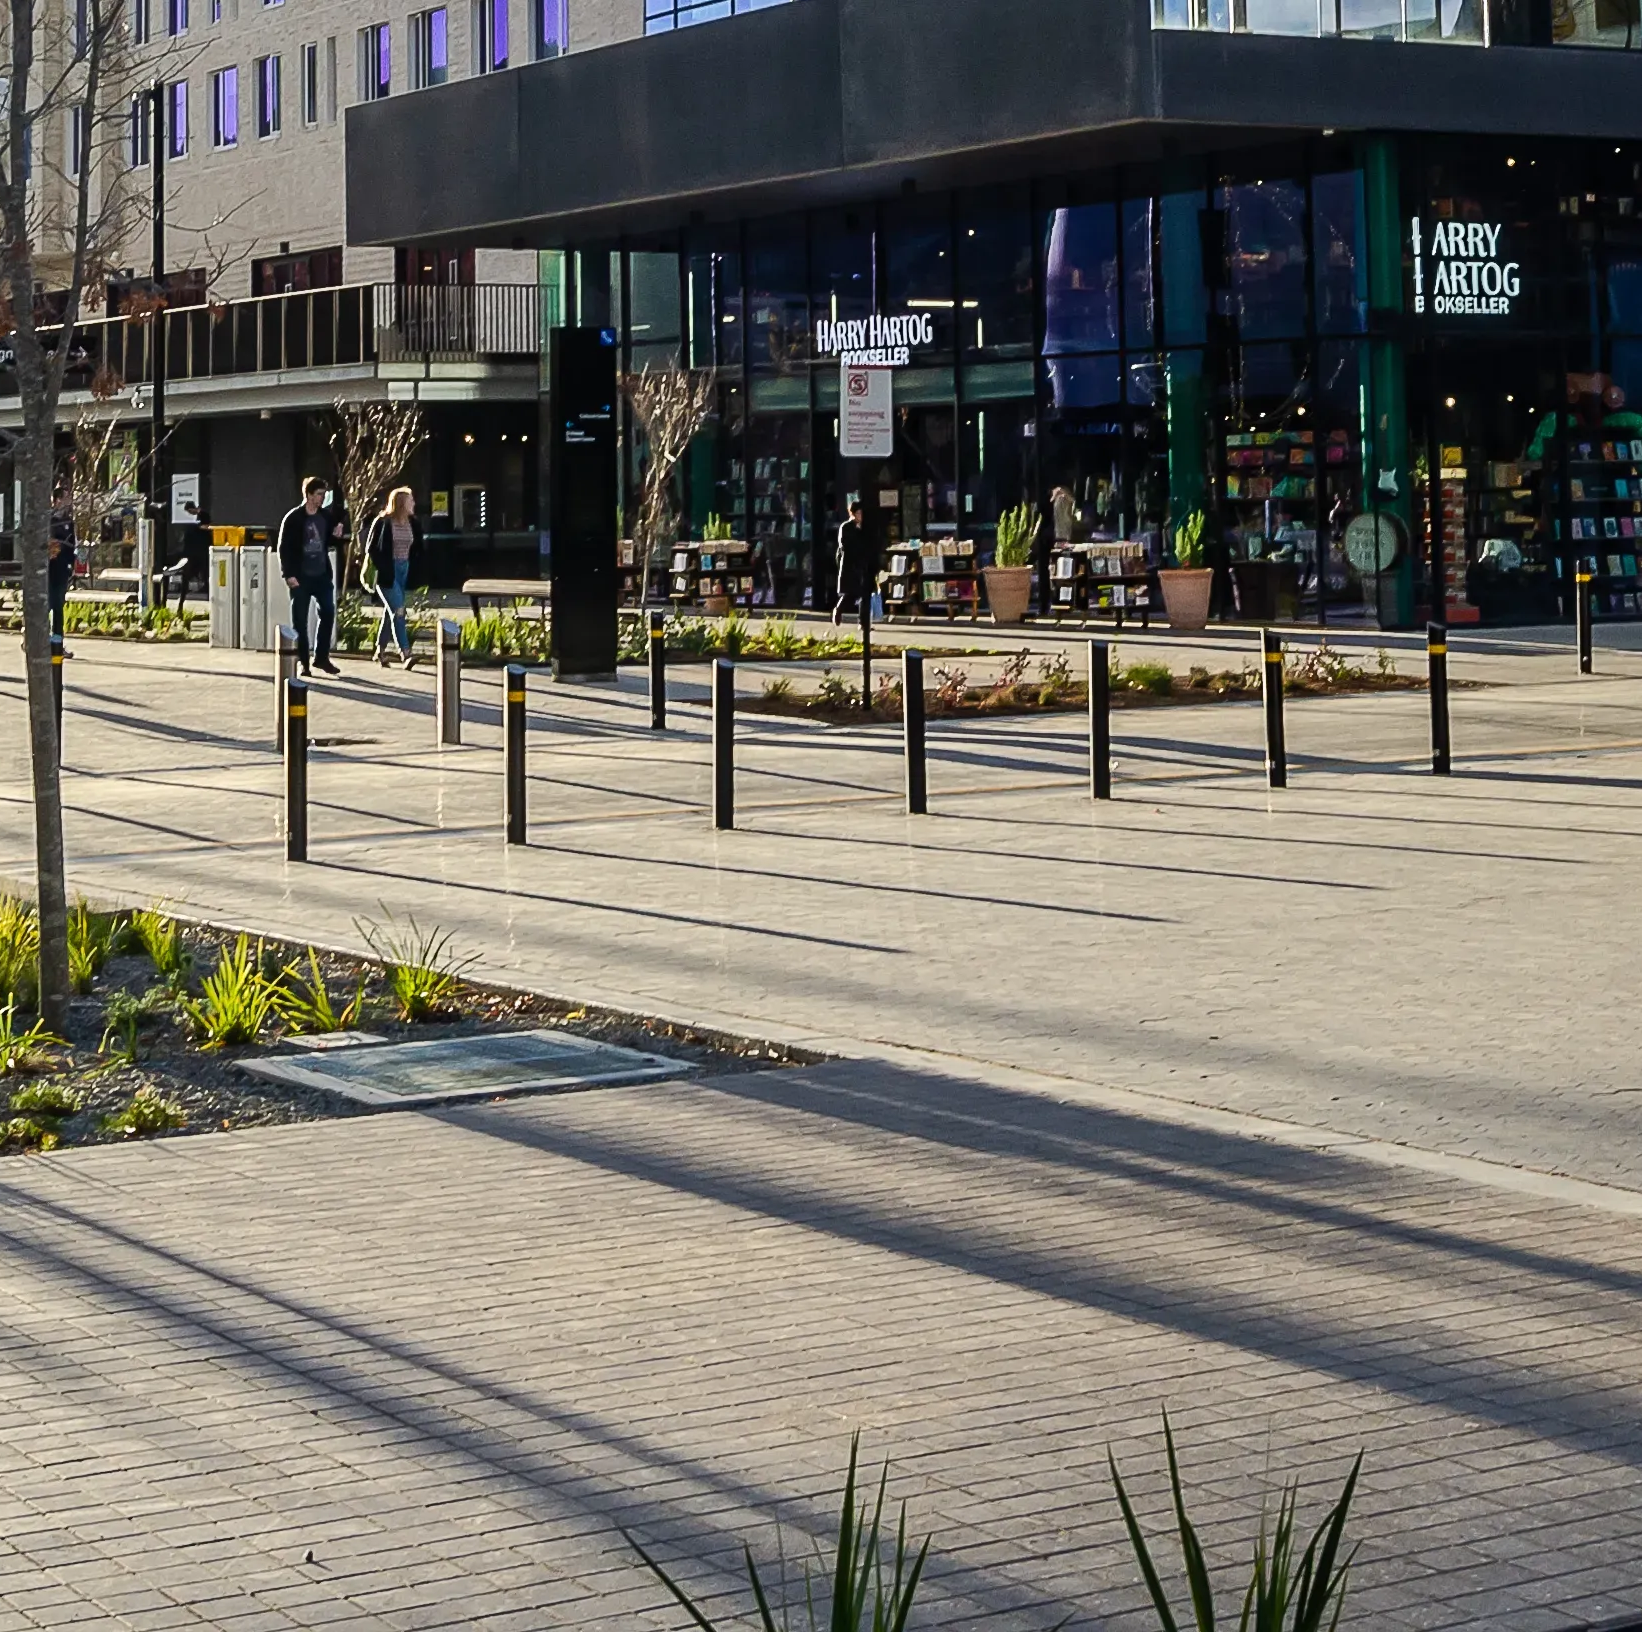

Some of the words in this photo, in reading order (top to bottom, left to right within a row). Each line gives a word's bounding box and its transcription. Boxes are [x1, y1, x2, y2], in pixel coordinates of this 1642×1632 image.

[1415, 295, 1510, 315] BOKSELLER
[816, 318, 868, 354] HARRY
[869, 312, 933, 348] HARTOG
[840, 346, 910, 366] BOOKSELLER
